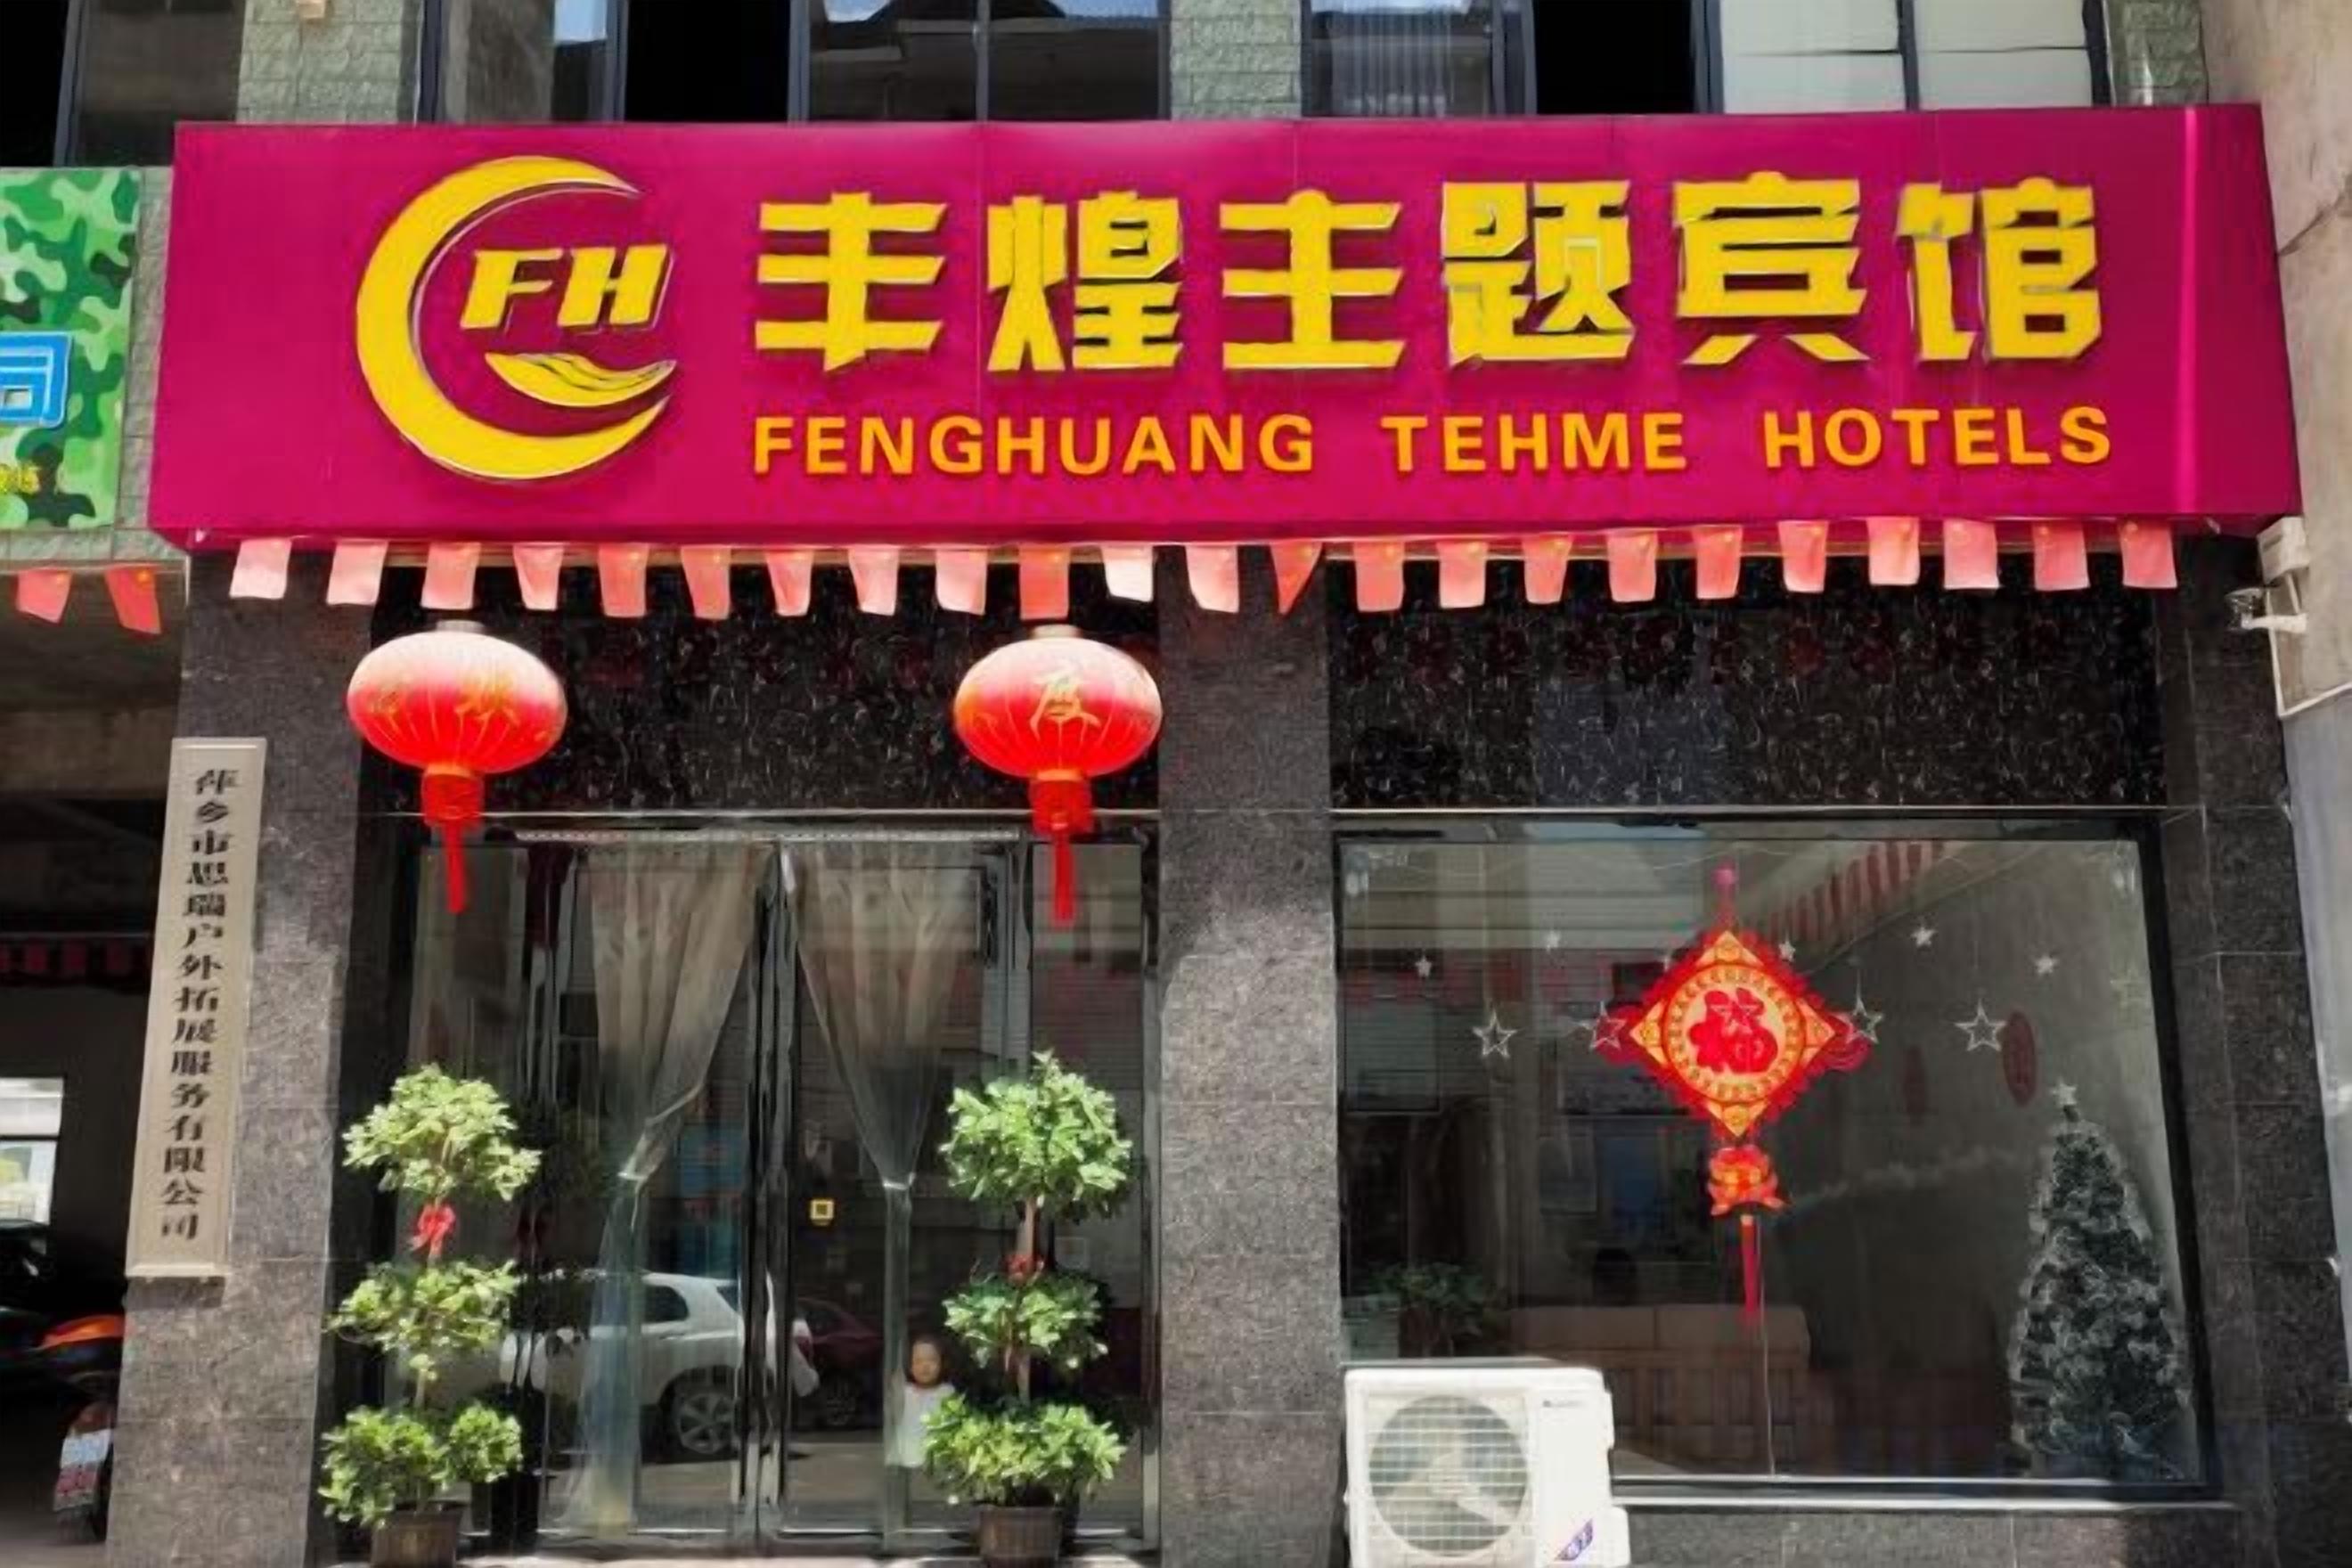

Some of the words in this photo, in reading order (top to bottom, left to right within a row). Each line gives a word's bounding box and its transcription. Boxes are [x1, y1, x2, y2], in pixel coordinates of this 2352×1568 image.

[461, 244, 668, 331] FH
[755, 172, 2103, 372] 丰煌主题宾馆
[754, 414, 1314, 475] FENGHUANG
[1382, 412, 1689, 473] TEHME
[1764, 405, 2111, 470] HOTELS
